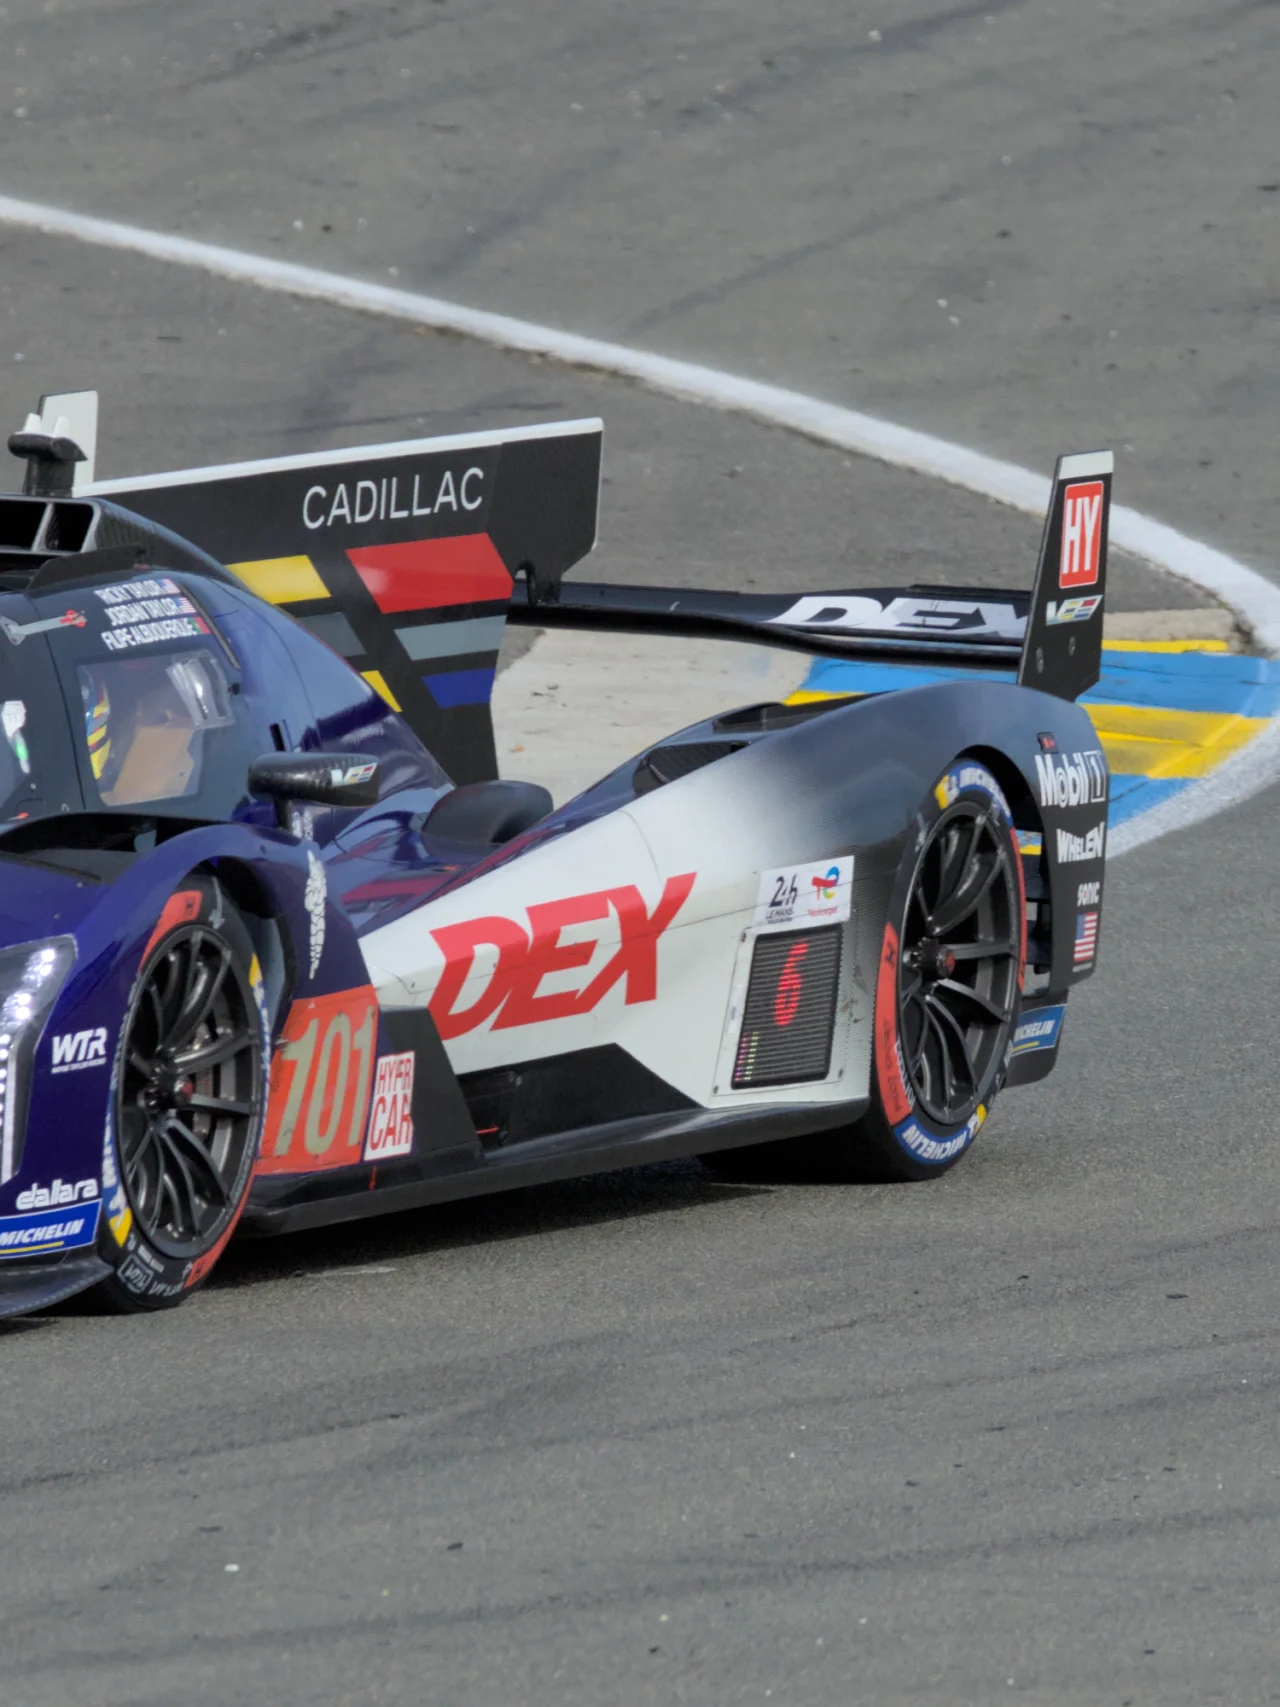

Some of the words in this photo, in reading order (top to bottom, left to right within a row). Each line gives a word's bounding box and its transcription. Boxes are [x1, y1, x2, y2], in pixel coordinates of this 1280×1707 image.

[302, 467, 484, 530] CADILLAC
[1062, 494, 1100, 575] HY
[1034, 752, 1089, 808] Mobil
[1056, 821, 1105, 864] WHELEN
[428, 872, 697, 1041] DEX
[51, 1026, 107, 1065] WTR
[273, 1005, 374, 1157] 101
[902, 1124, 968, 1160] MICHELIN
[16, 1178, 99, 1211] dallara
